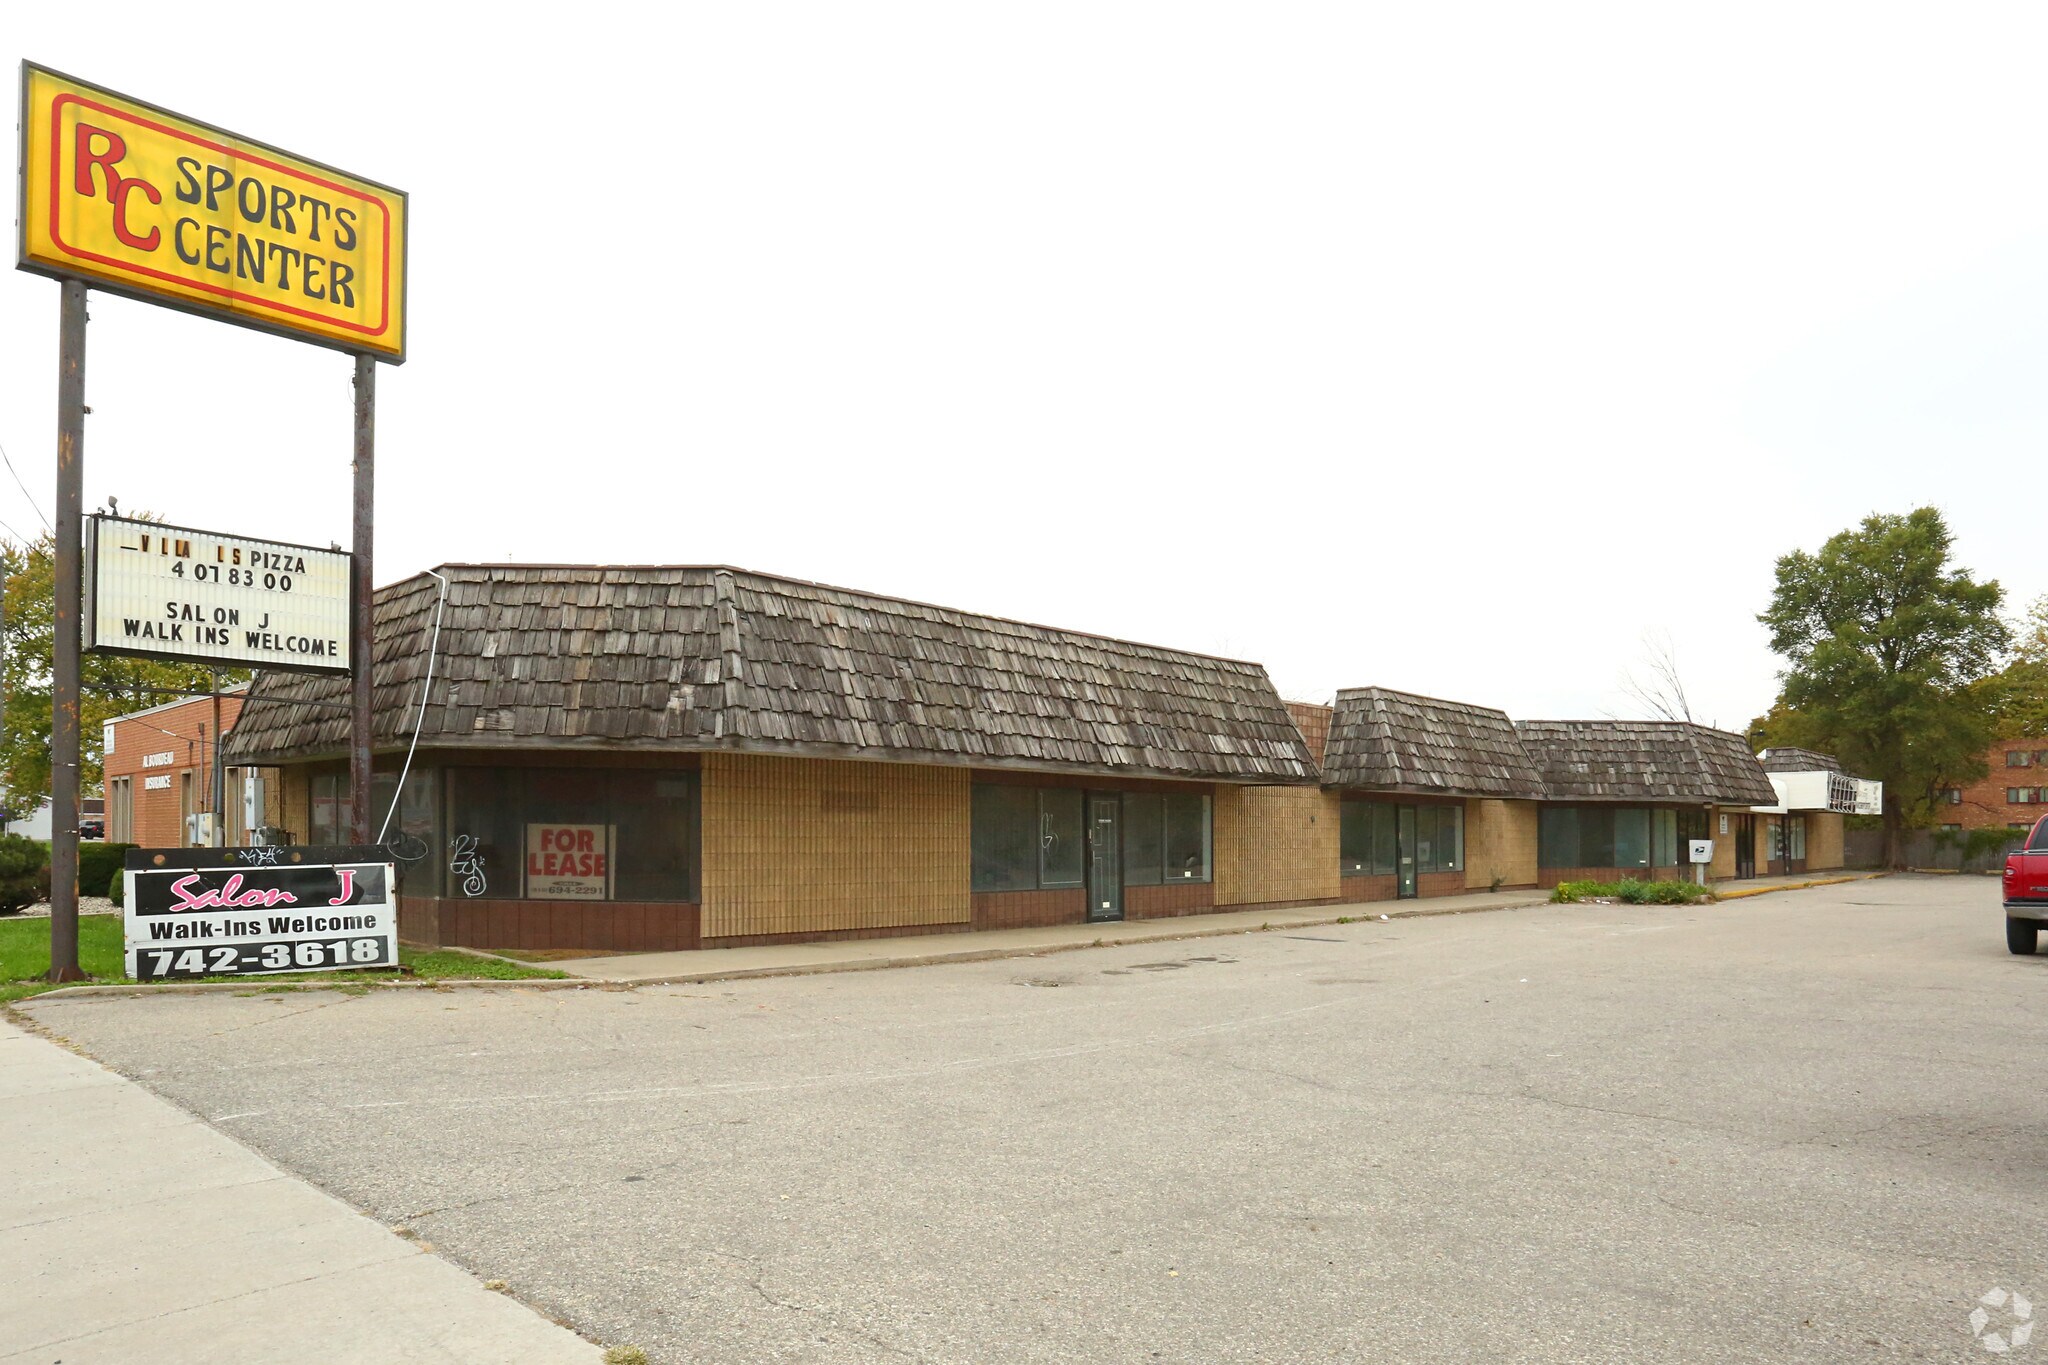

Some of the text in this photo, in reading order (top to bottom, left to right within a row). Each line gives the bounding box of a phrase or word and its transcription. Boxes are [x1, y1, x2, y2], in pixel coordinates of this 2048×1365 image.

[74, 121, 163, 252] RC
[175, 156, 358, 252] SPORTS
[173, 216, 356, 309] CENTER
[250, 550, 306, 574] PIZZA
[123, 618, 338, 657] WALK INS WELCOME
[258, 613, 270, 629] J
[540, 828, 595, 853] FOR
[528, 853, 606, 878] LEASE
[168, 869, 358, 913] Salon J
[149, 914, 377, 940] Walk-Ins Welcome
[147, 938, 380, 976] 742-3618
